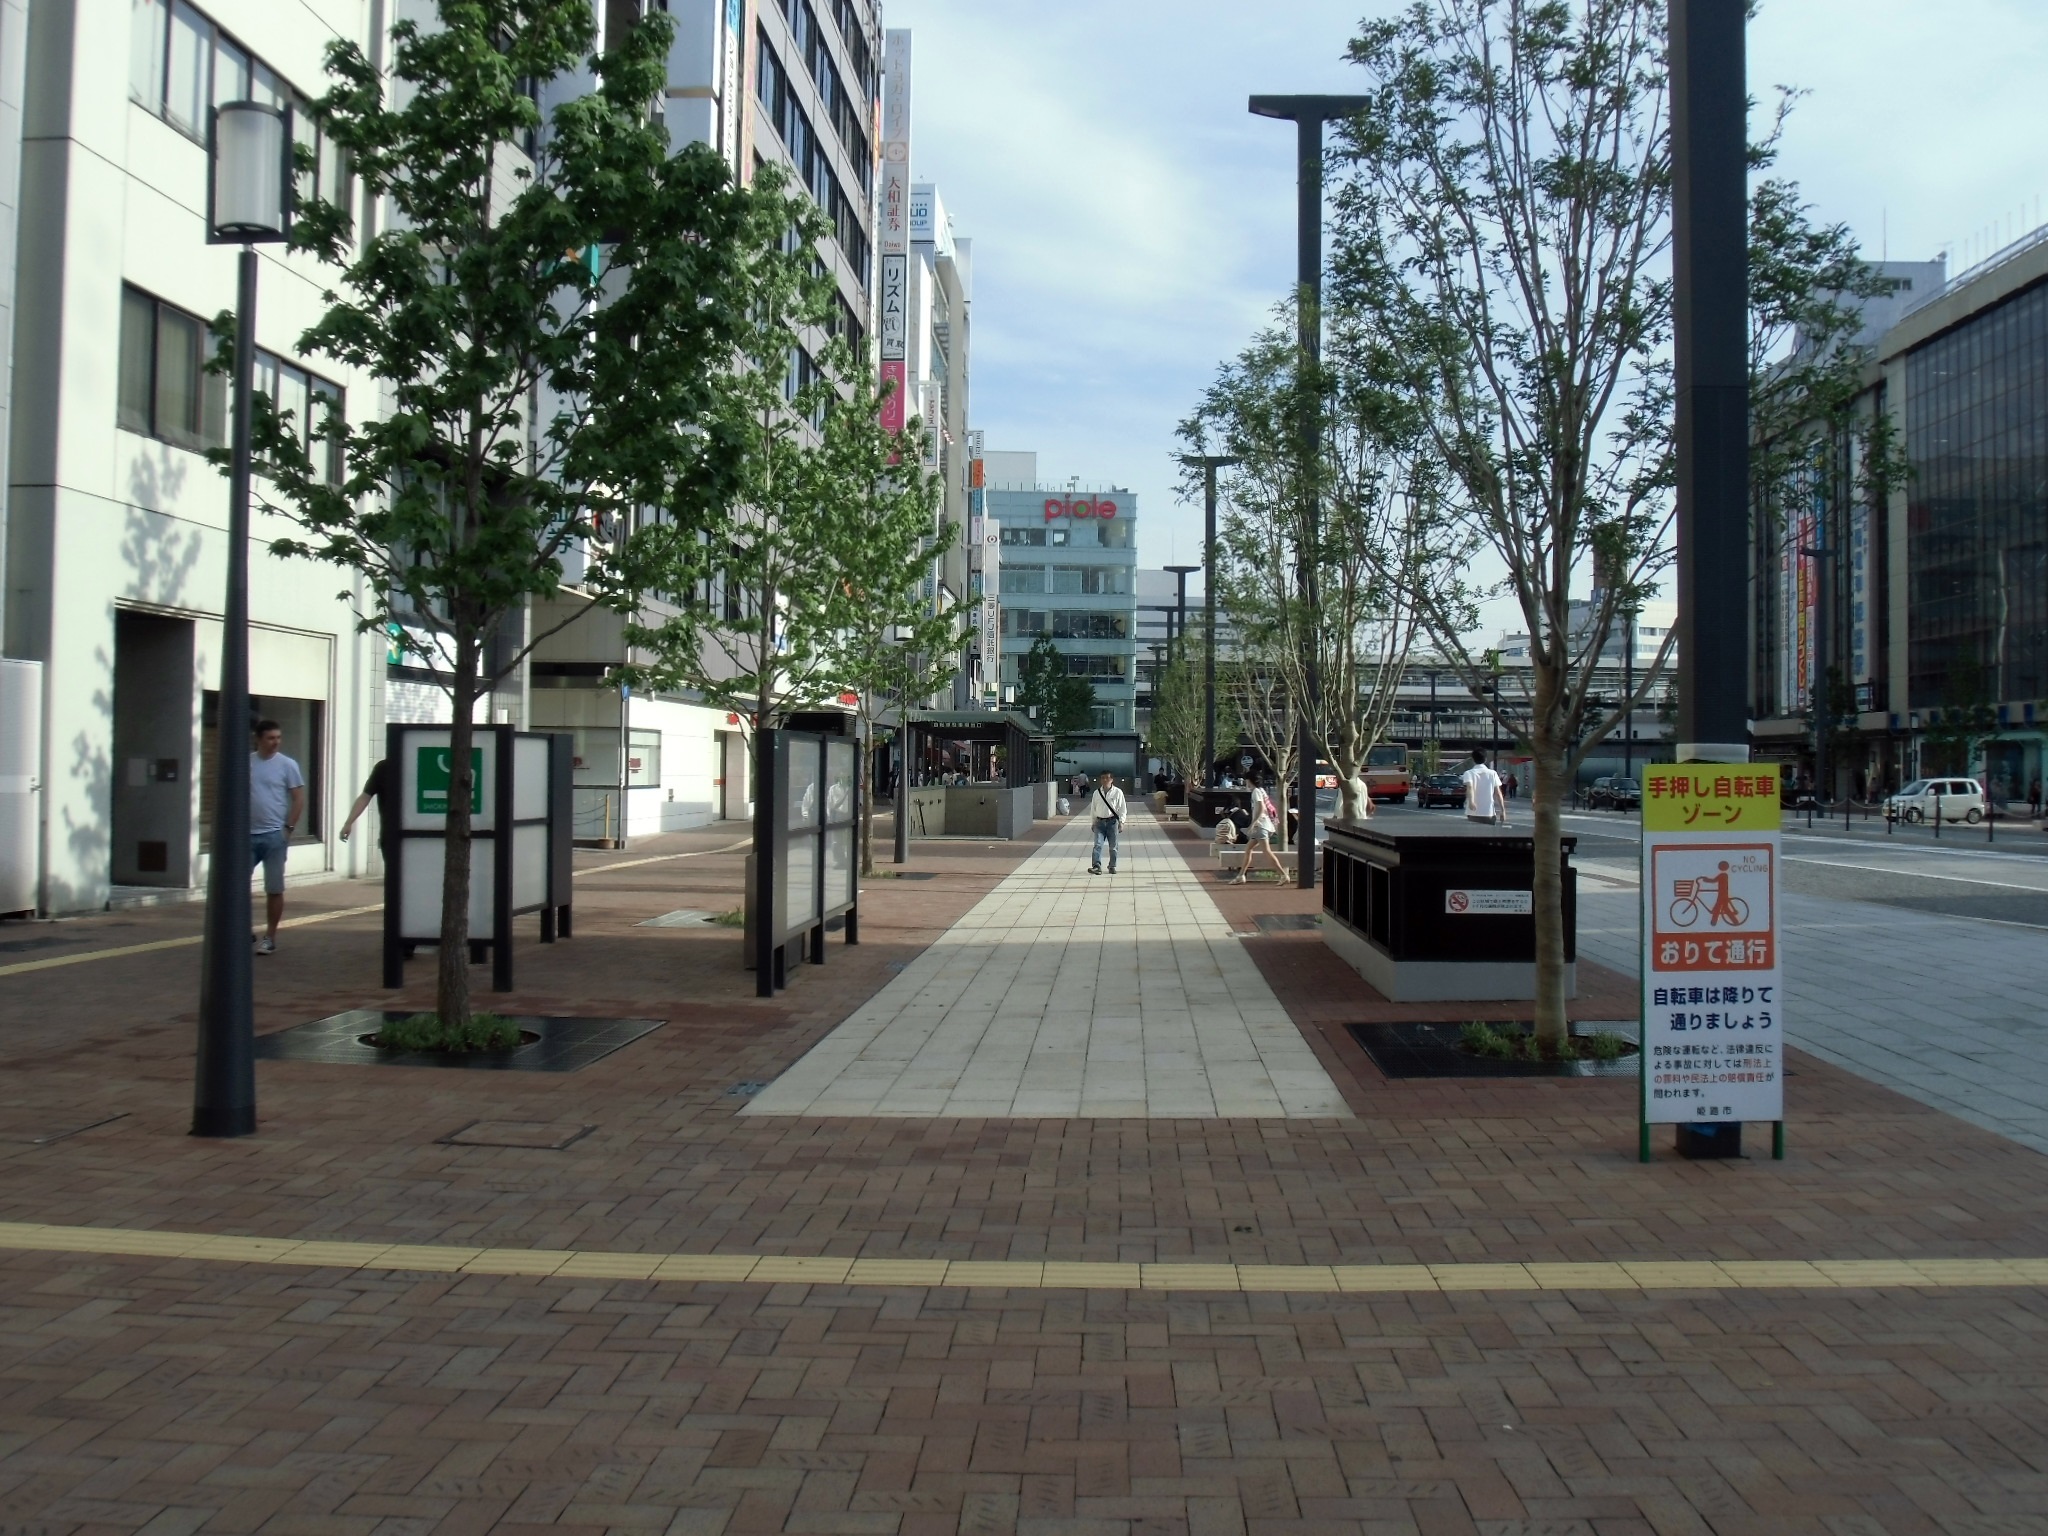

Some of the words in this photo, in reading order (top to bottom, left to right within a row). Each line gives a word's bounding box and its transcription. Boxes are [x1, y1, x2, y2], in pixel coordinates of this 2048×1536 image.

[887, 176, 901, 231] 大和証券
[884, 240, 901, 248] Daiwa
[886, 267, 901, 314] リズム
[1044, 493, 1117, 525] piole
[987, 593, 995, 663] 三菱UFJ信託銀行
[1647, 775, 1775, 799] 手押し自転車
[1682, 803, 1742, 825] ゾーン
[1731, 865, 1769, 873] CYCLING
[1660, 939, 1768, 965] おりて通行
[1653, 986, 1773, 1006] 自転車は降りて
[1670, 1012, 1772, 1031] 通りましょう
[1654, 1058, 1772, 1070] よる事故に対しては刑法上
[1653, 1089, 1706, 1099] 問われます。
